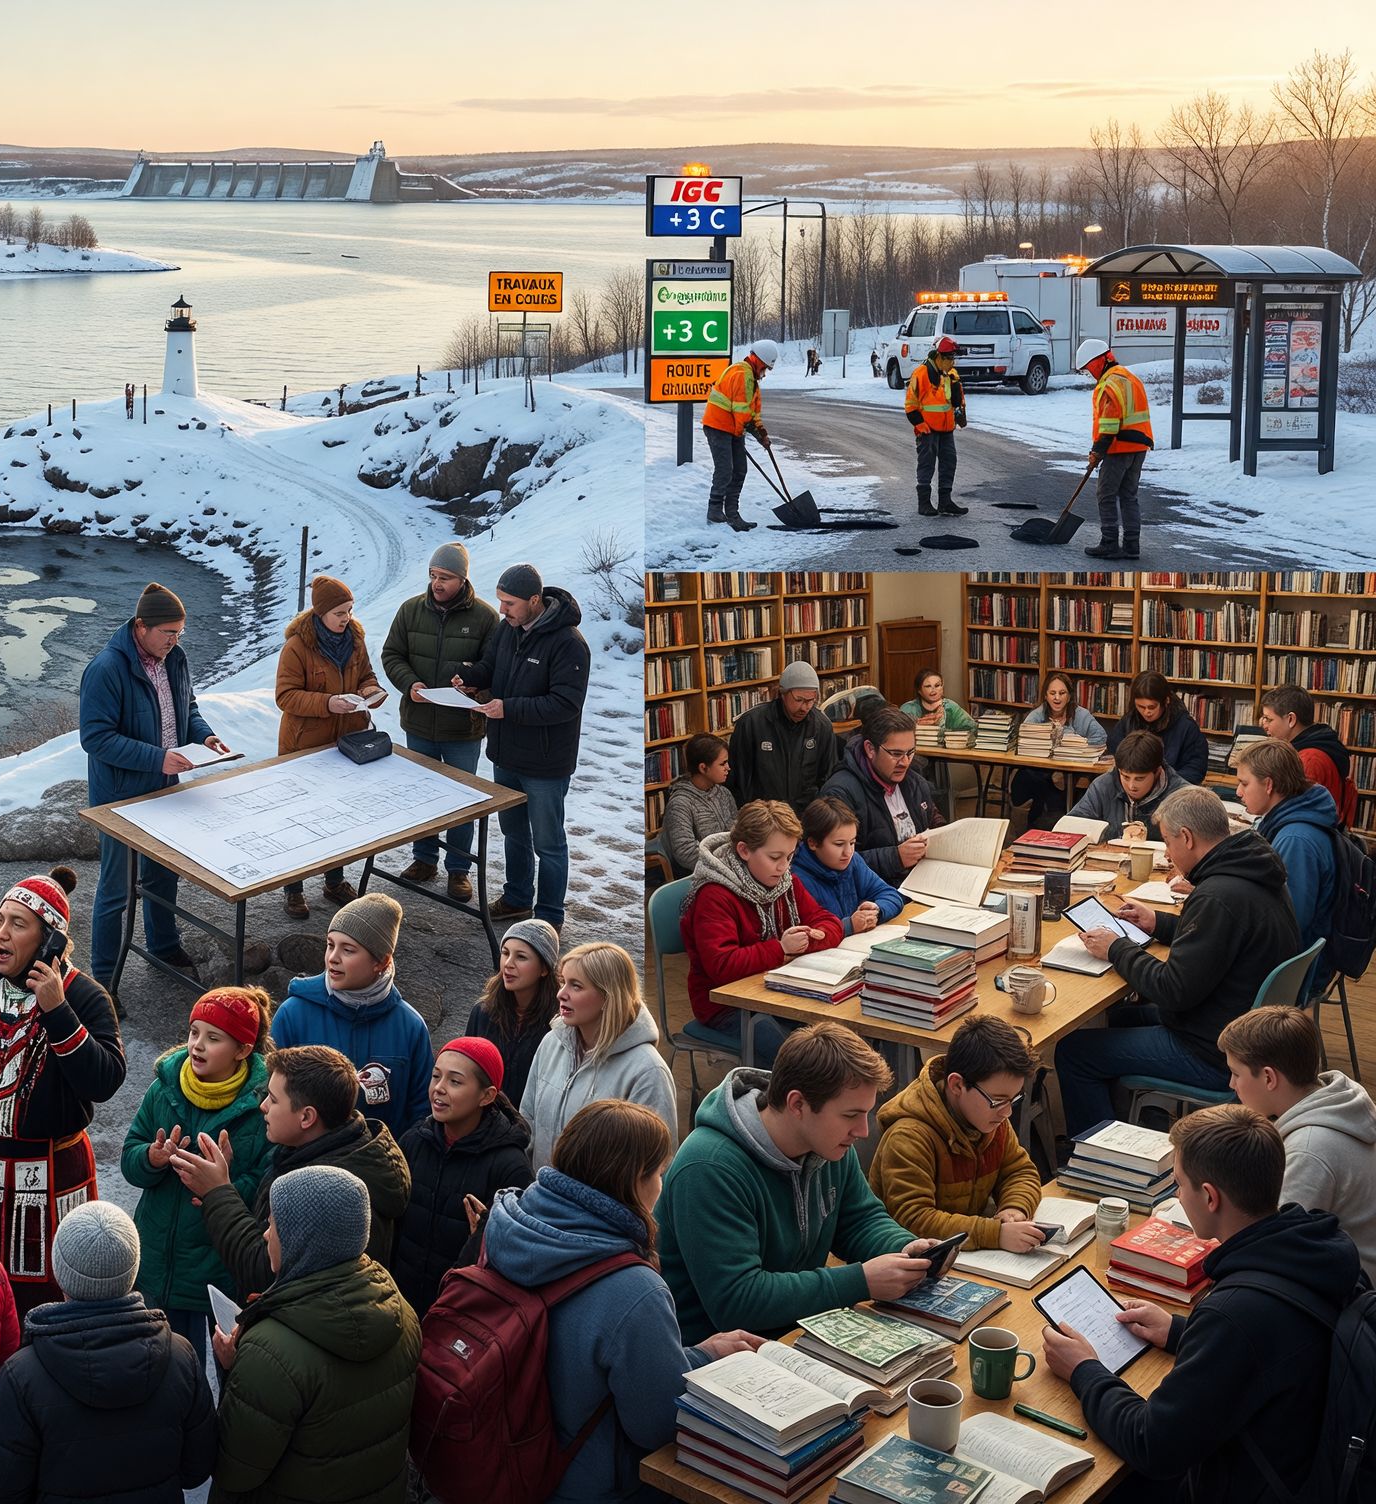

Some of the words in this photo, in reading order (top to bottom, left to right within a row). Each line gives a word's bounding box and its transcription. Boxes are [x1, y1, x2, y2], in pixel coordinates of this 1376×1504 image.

[670, 181, 723, 203] IGC
[710, 208, 725, 230] C
[497, 278, 556, 290] TRAVAUX
[494, 294, 511, 304] EN
[703, 320, 718, 342] C
[667, 364, 711, 377] ROUTE
